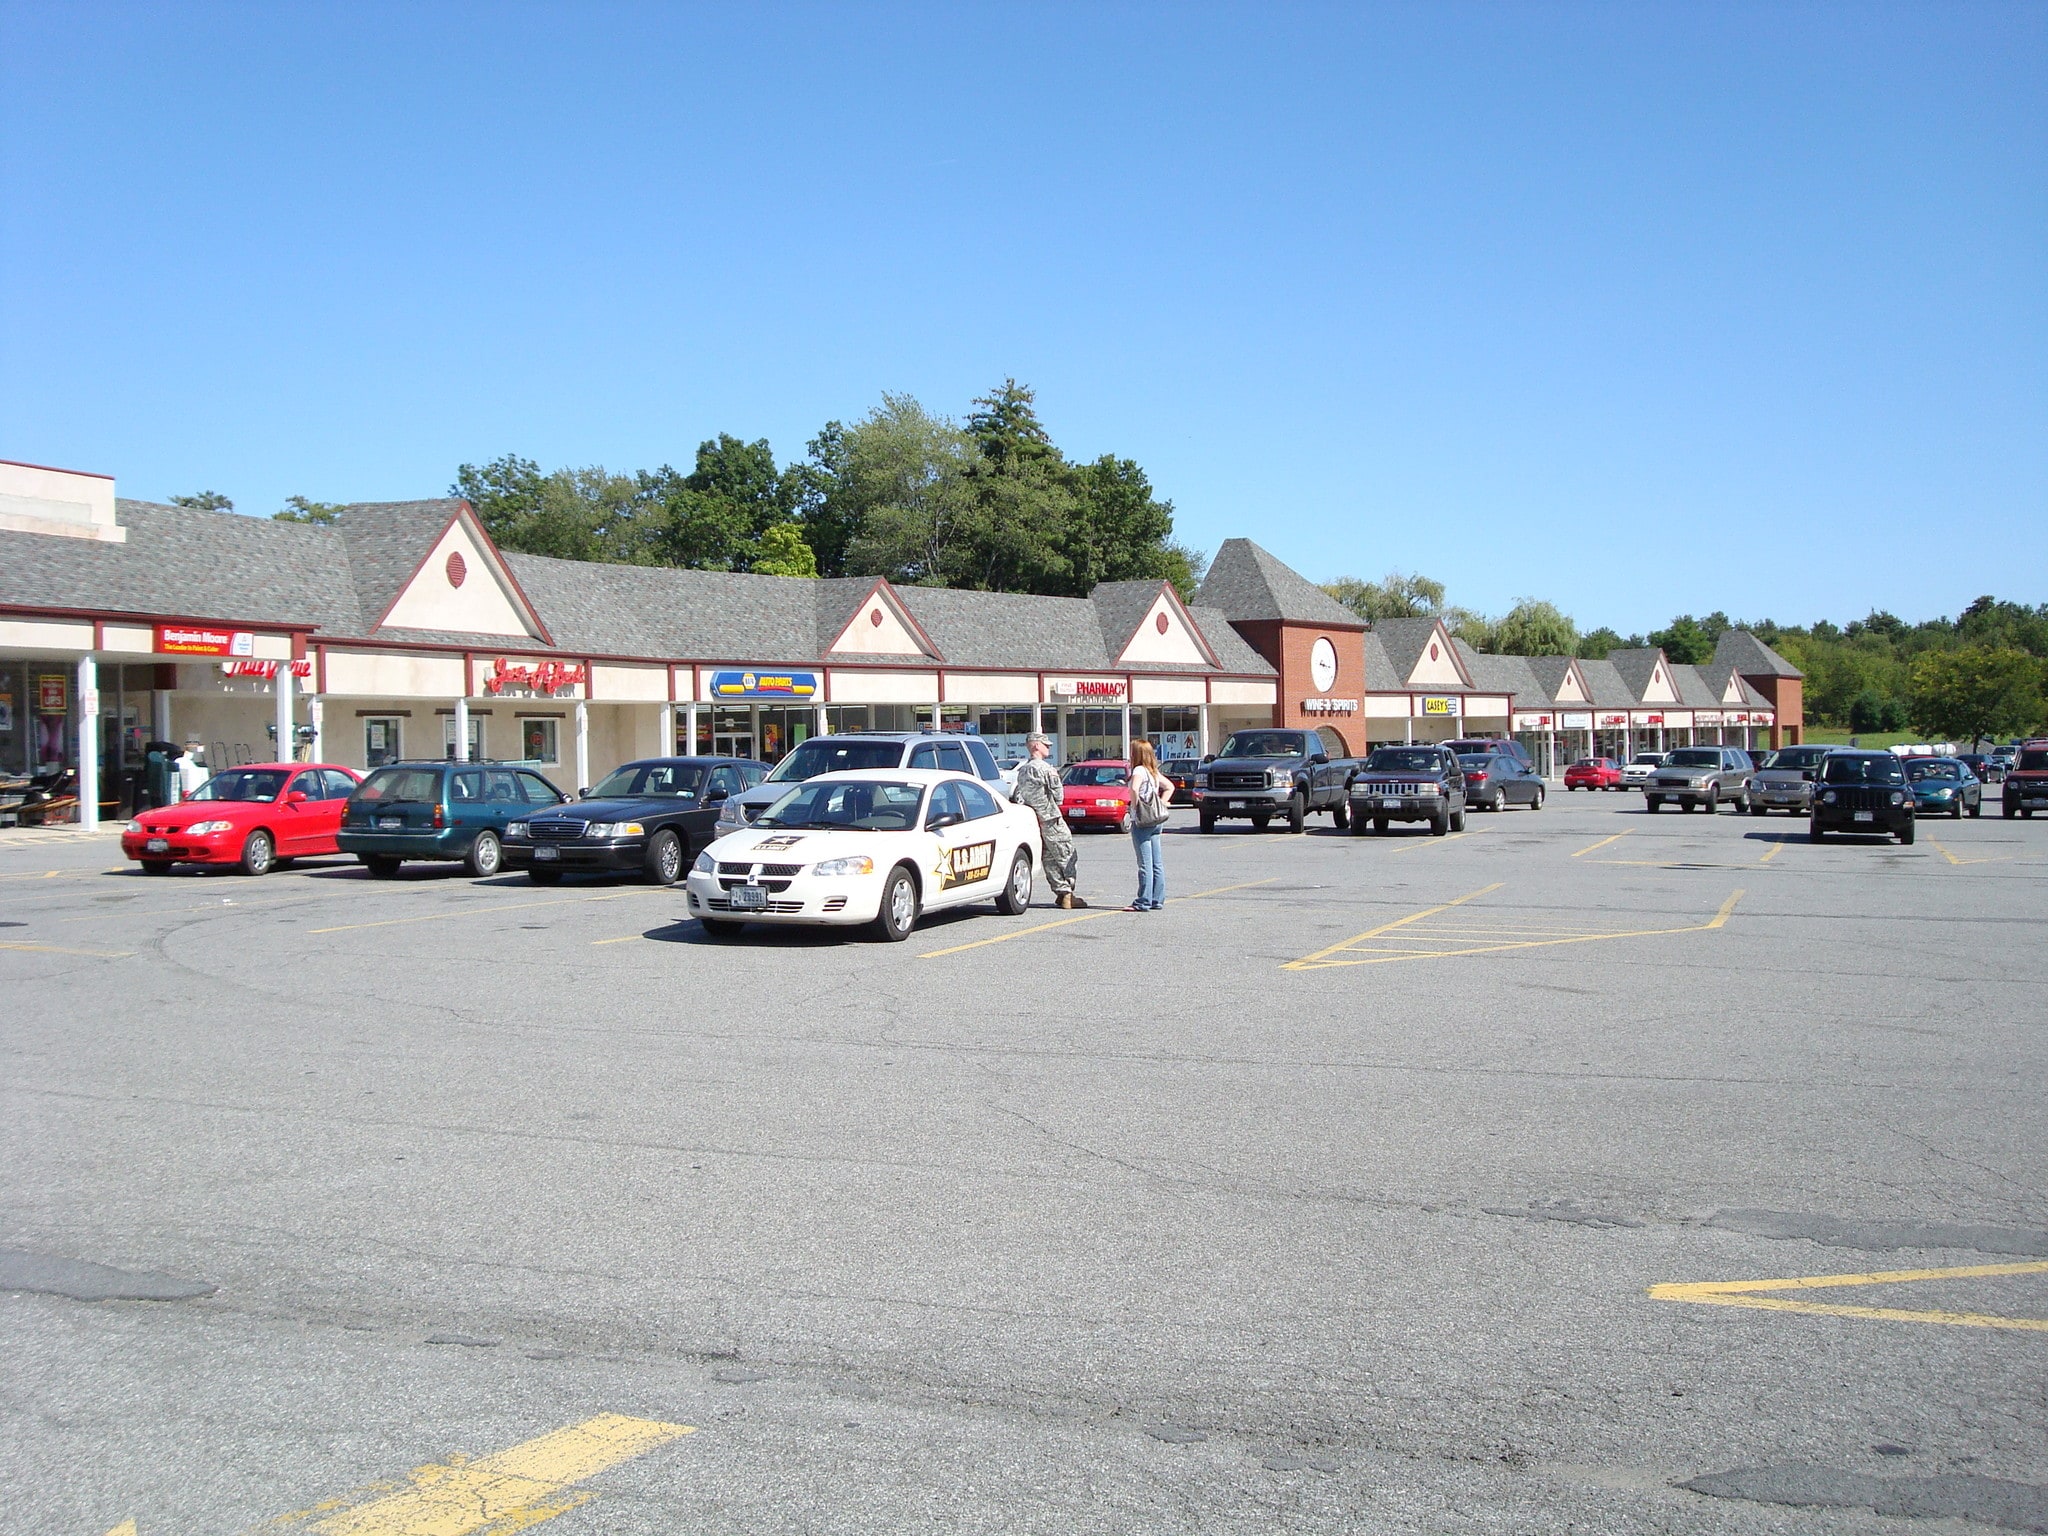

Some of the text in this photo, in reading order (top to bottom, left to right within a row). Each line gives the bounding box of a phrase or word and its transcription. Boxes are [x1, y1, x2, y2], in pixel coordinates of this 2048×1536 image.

[164, 629, 228, 644] Benjamin Moore
[759, 677, 793, 686] AUTO PARTS
[1076, 682, 1126, 695] PHARMACY
[1427, 700, 1448, 711] CASEY'S
[1167, 734, 1177, 744] Gift
